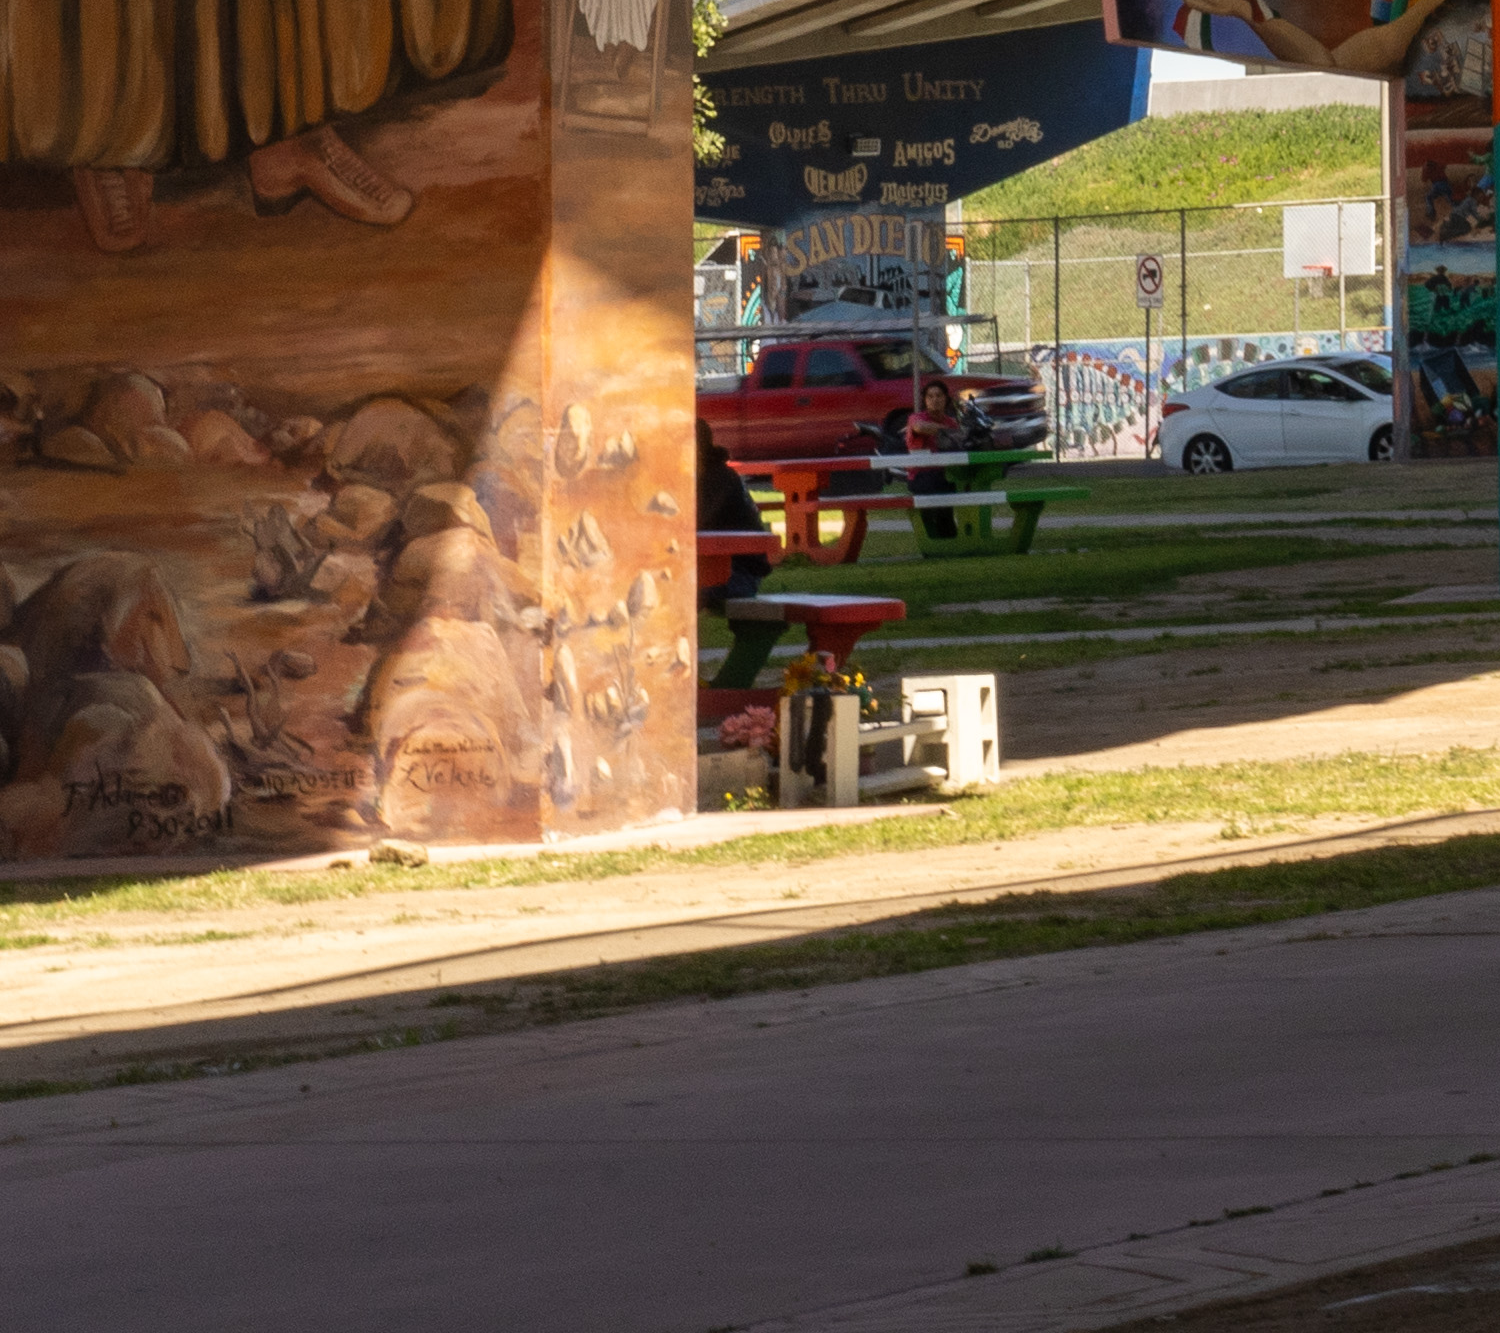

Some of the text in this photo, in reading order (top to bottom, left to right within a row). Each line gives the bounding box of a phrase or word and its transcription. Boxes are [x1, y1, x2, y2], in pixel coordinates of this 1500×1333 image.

[712, 85, 806, 106] RENGTH
[783, 213, 945, 276] SAN DIEO
